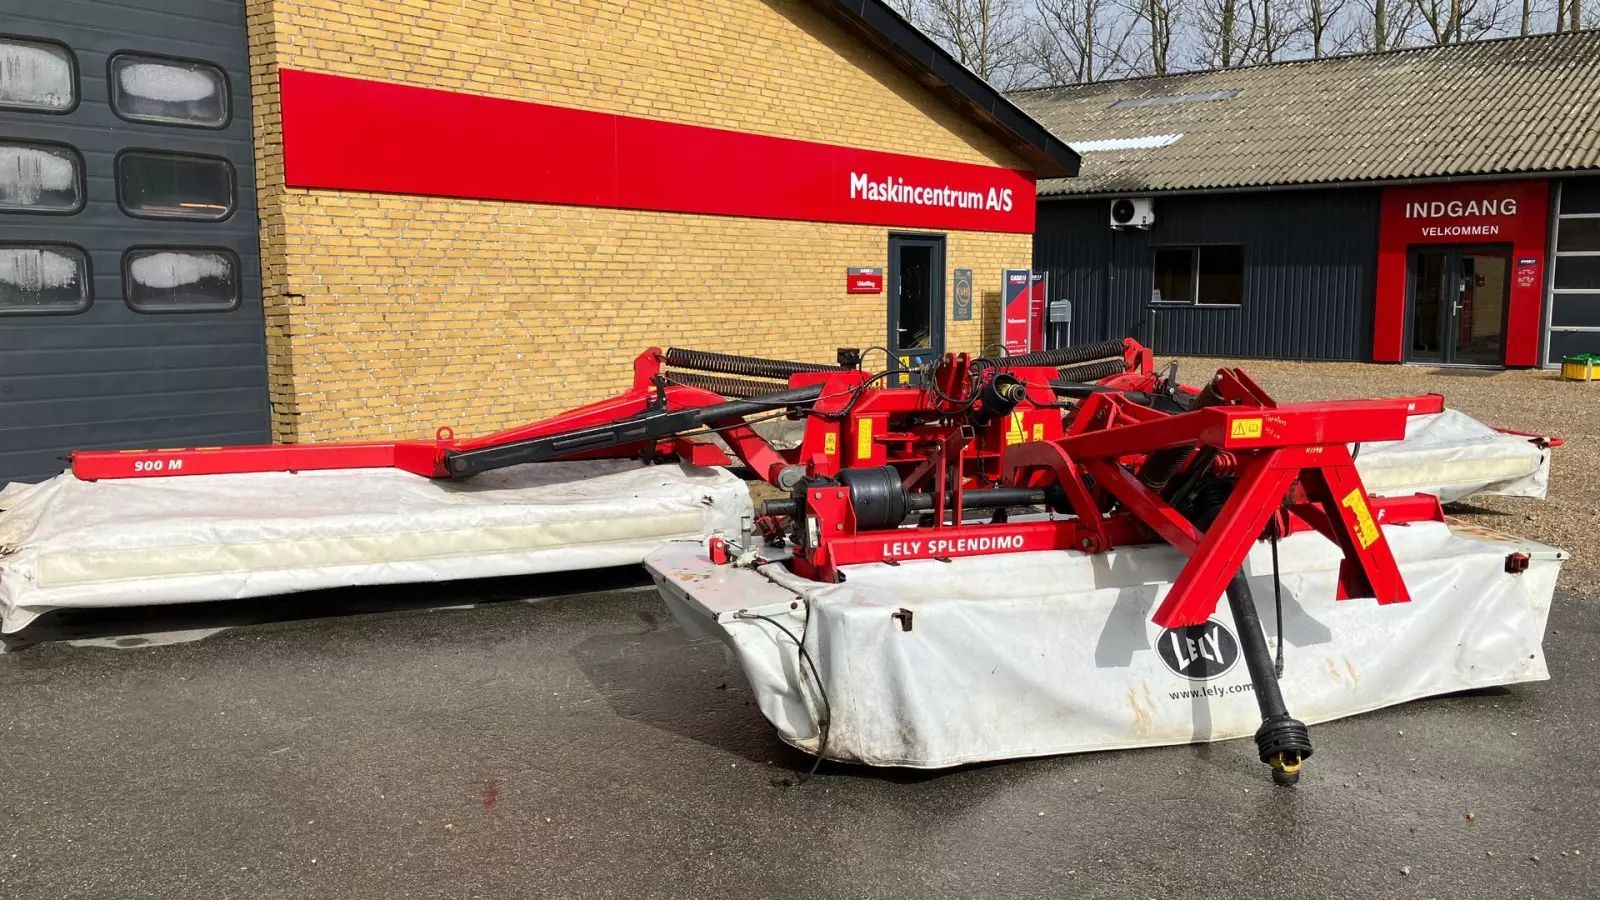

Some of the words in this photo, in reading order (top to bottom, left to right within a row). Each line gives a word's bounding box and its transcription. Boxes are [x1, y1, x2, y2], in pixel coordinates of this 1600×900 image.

[850, 172, 983, 209] Maskincentrum
[985, 187, 1013, 213] A/S
[1405, 199, 1517, 218] INDGANG
[1422, 226, 1499, 236] VELKOMMEN
[134, 460, 163, 471] 900
[168, 459, 182, 470] M
[1377, 509, 1386, 521] F
[883, 541, 922, 557] LELY
[928, 536, 1024, 554] SPLENDIMO
[1170, 626, 1224, 670] LELY
[1169, 683, 1255, 699] www.lely.com
